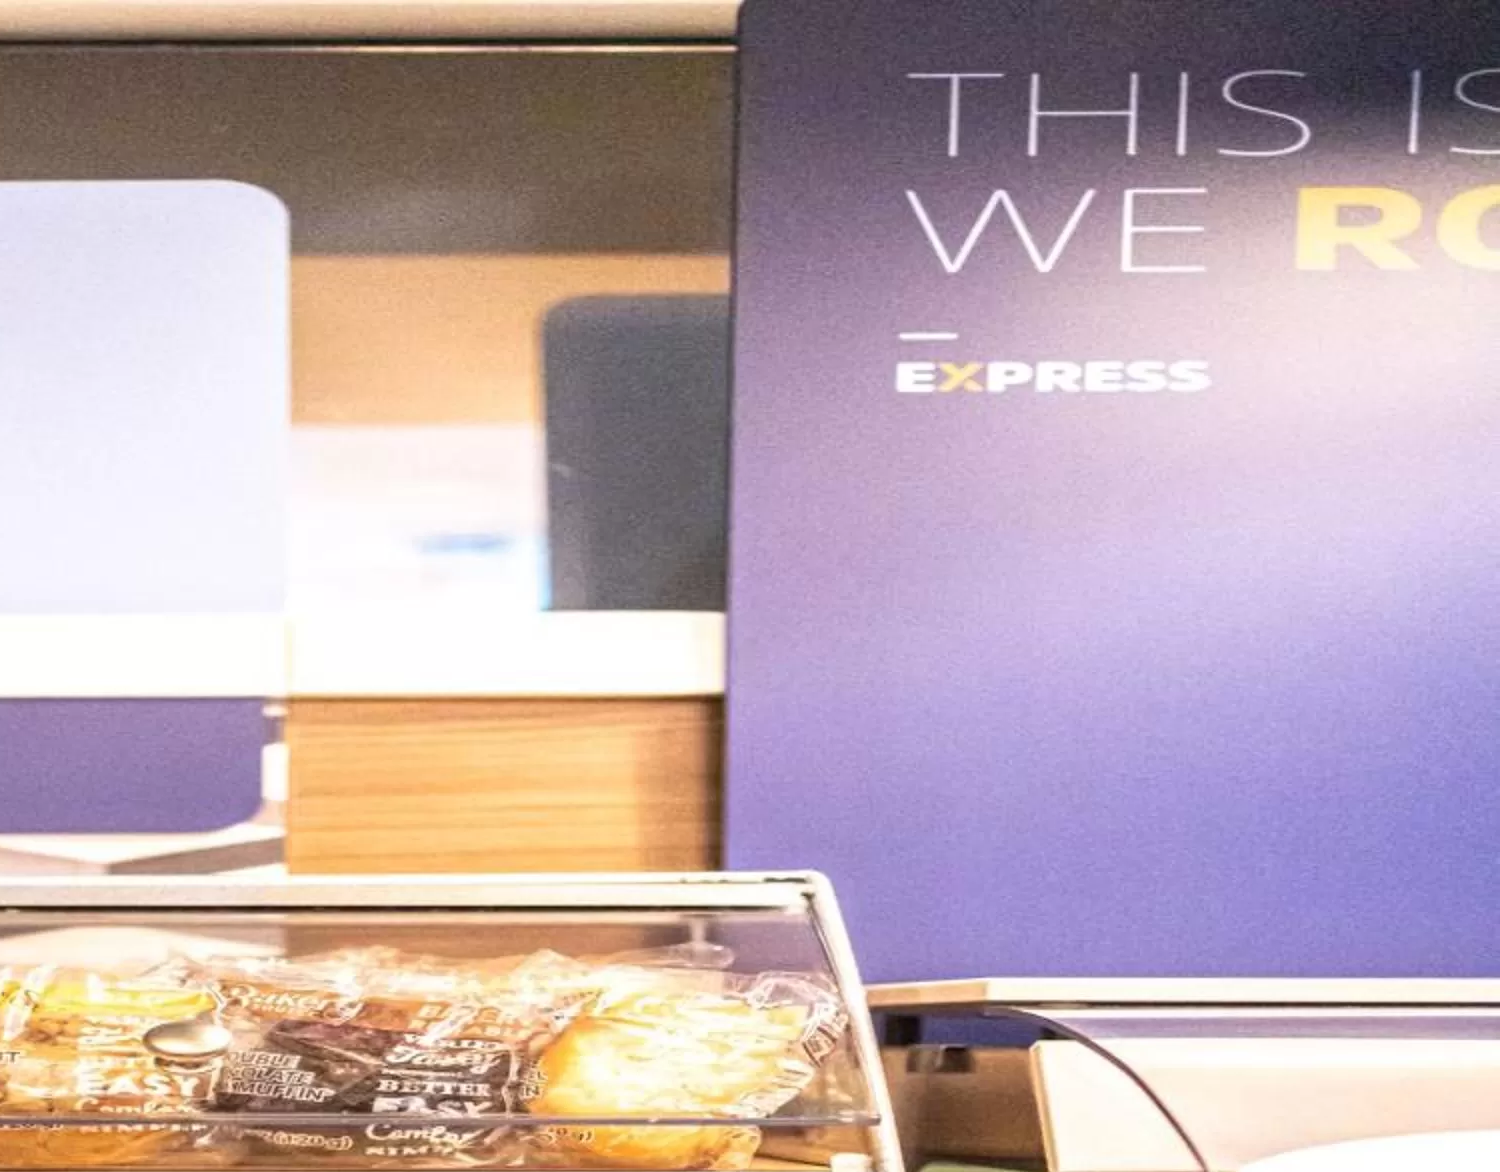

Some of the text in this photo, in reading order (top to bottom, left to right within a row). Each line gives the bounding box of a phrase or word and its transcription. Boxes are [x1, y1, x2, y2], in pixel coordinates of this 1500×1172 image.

[906, 68, 1500, 157] THIS IS
[905, 188, 1208, 273] WE
[895, 360, 1211, 394] EXPRESS
